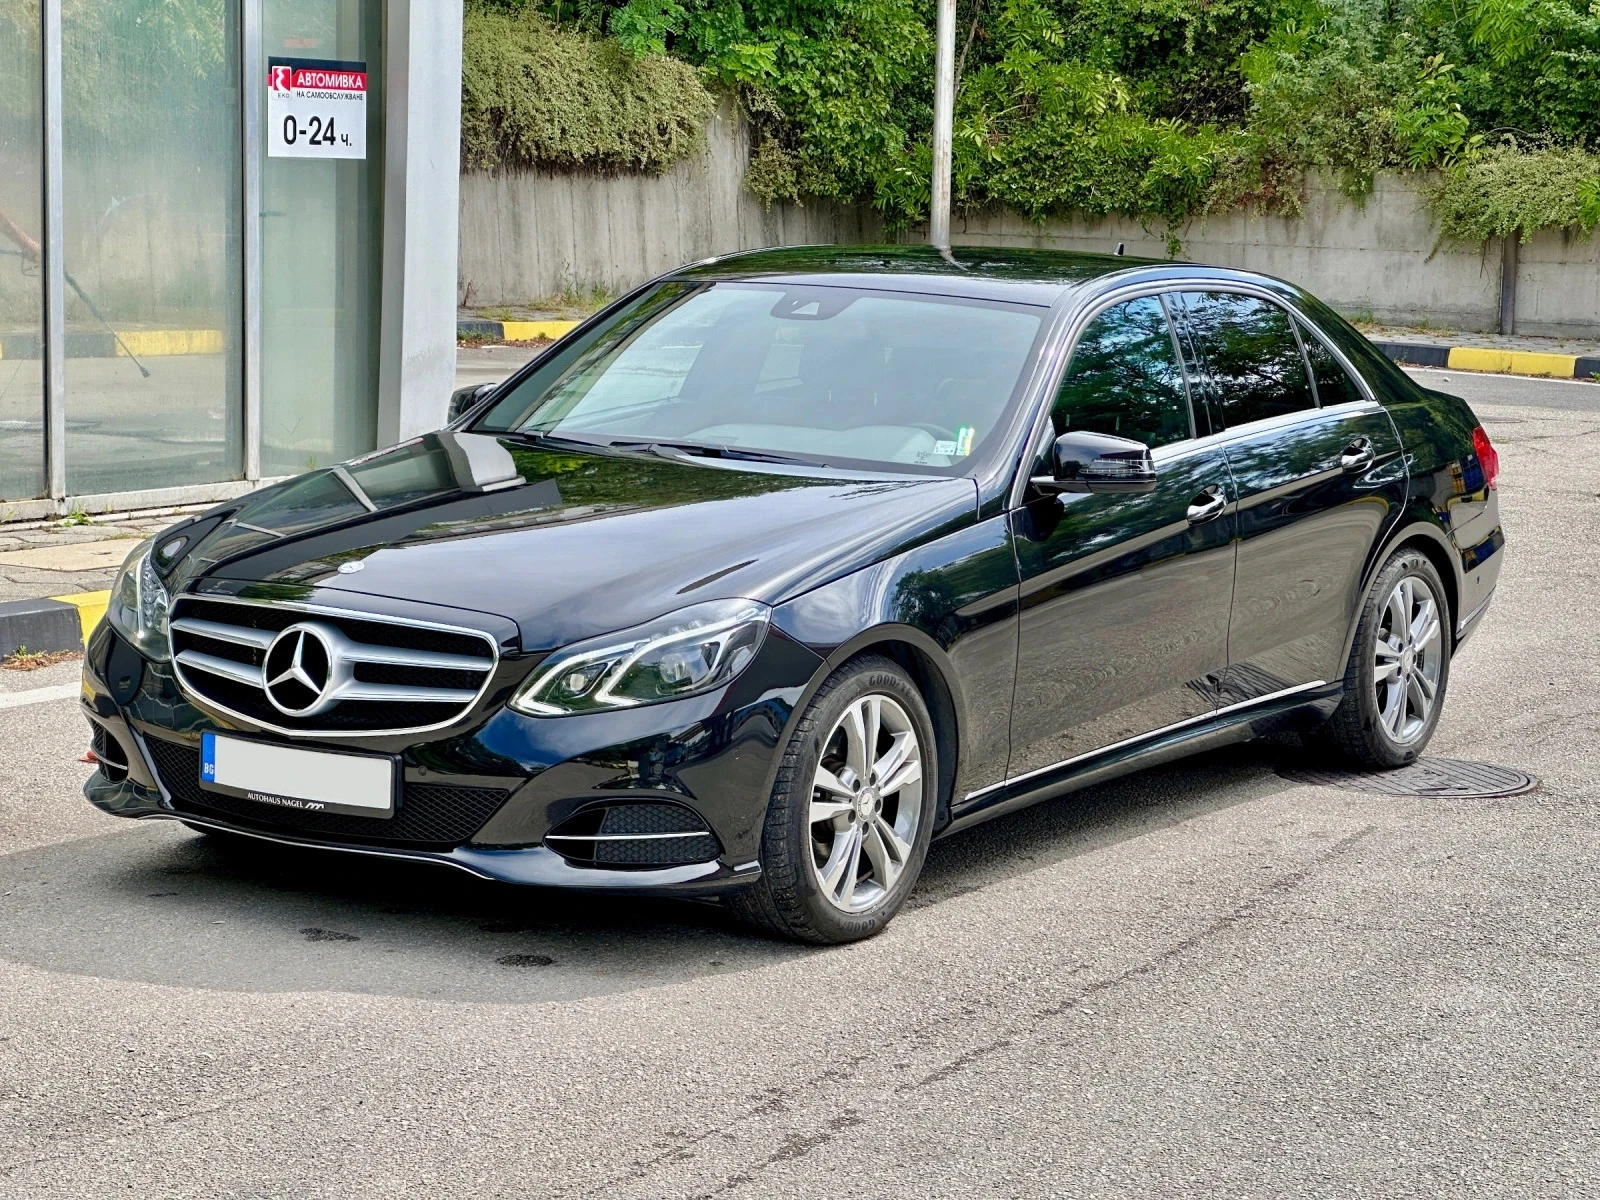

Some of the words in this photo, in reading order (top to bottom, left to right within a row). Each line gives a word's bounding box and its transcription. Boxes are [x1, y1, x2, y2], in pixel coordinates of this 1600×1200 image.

[296, 72, 364, 89] АВТОМИВКА
[306, 91, 364, 101] САМООБСЛУЖВАНЕ
[283, 114, 337, 146] 0-24
[340, 133, 352, 147] ч.
[203, 762, 215, 775] BG
[247, 792, 281, 805] AUTOHAUS
[281, 798, 304, 809] NAGEL
